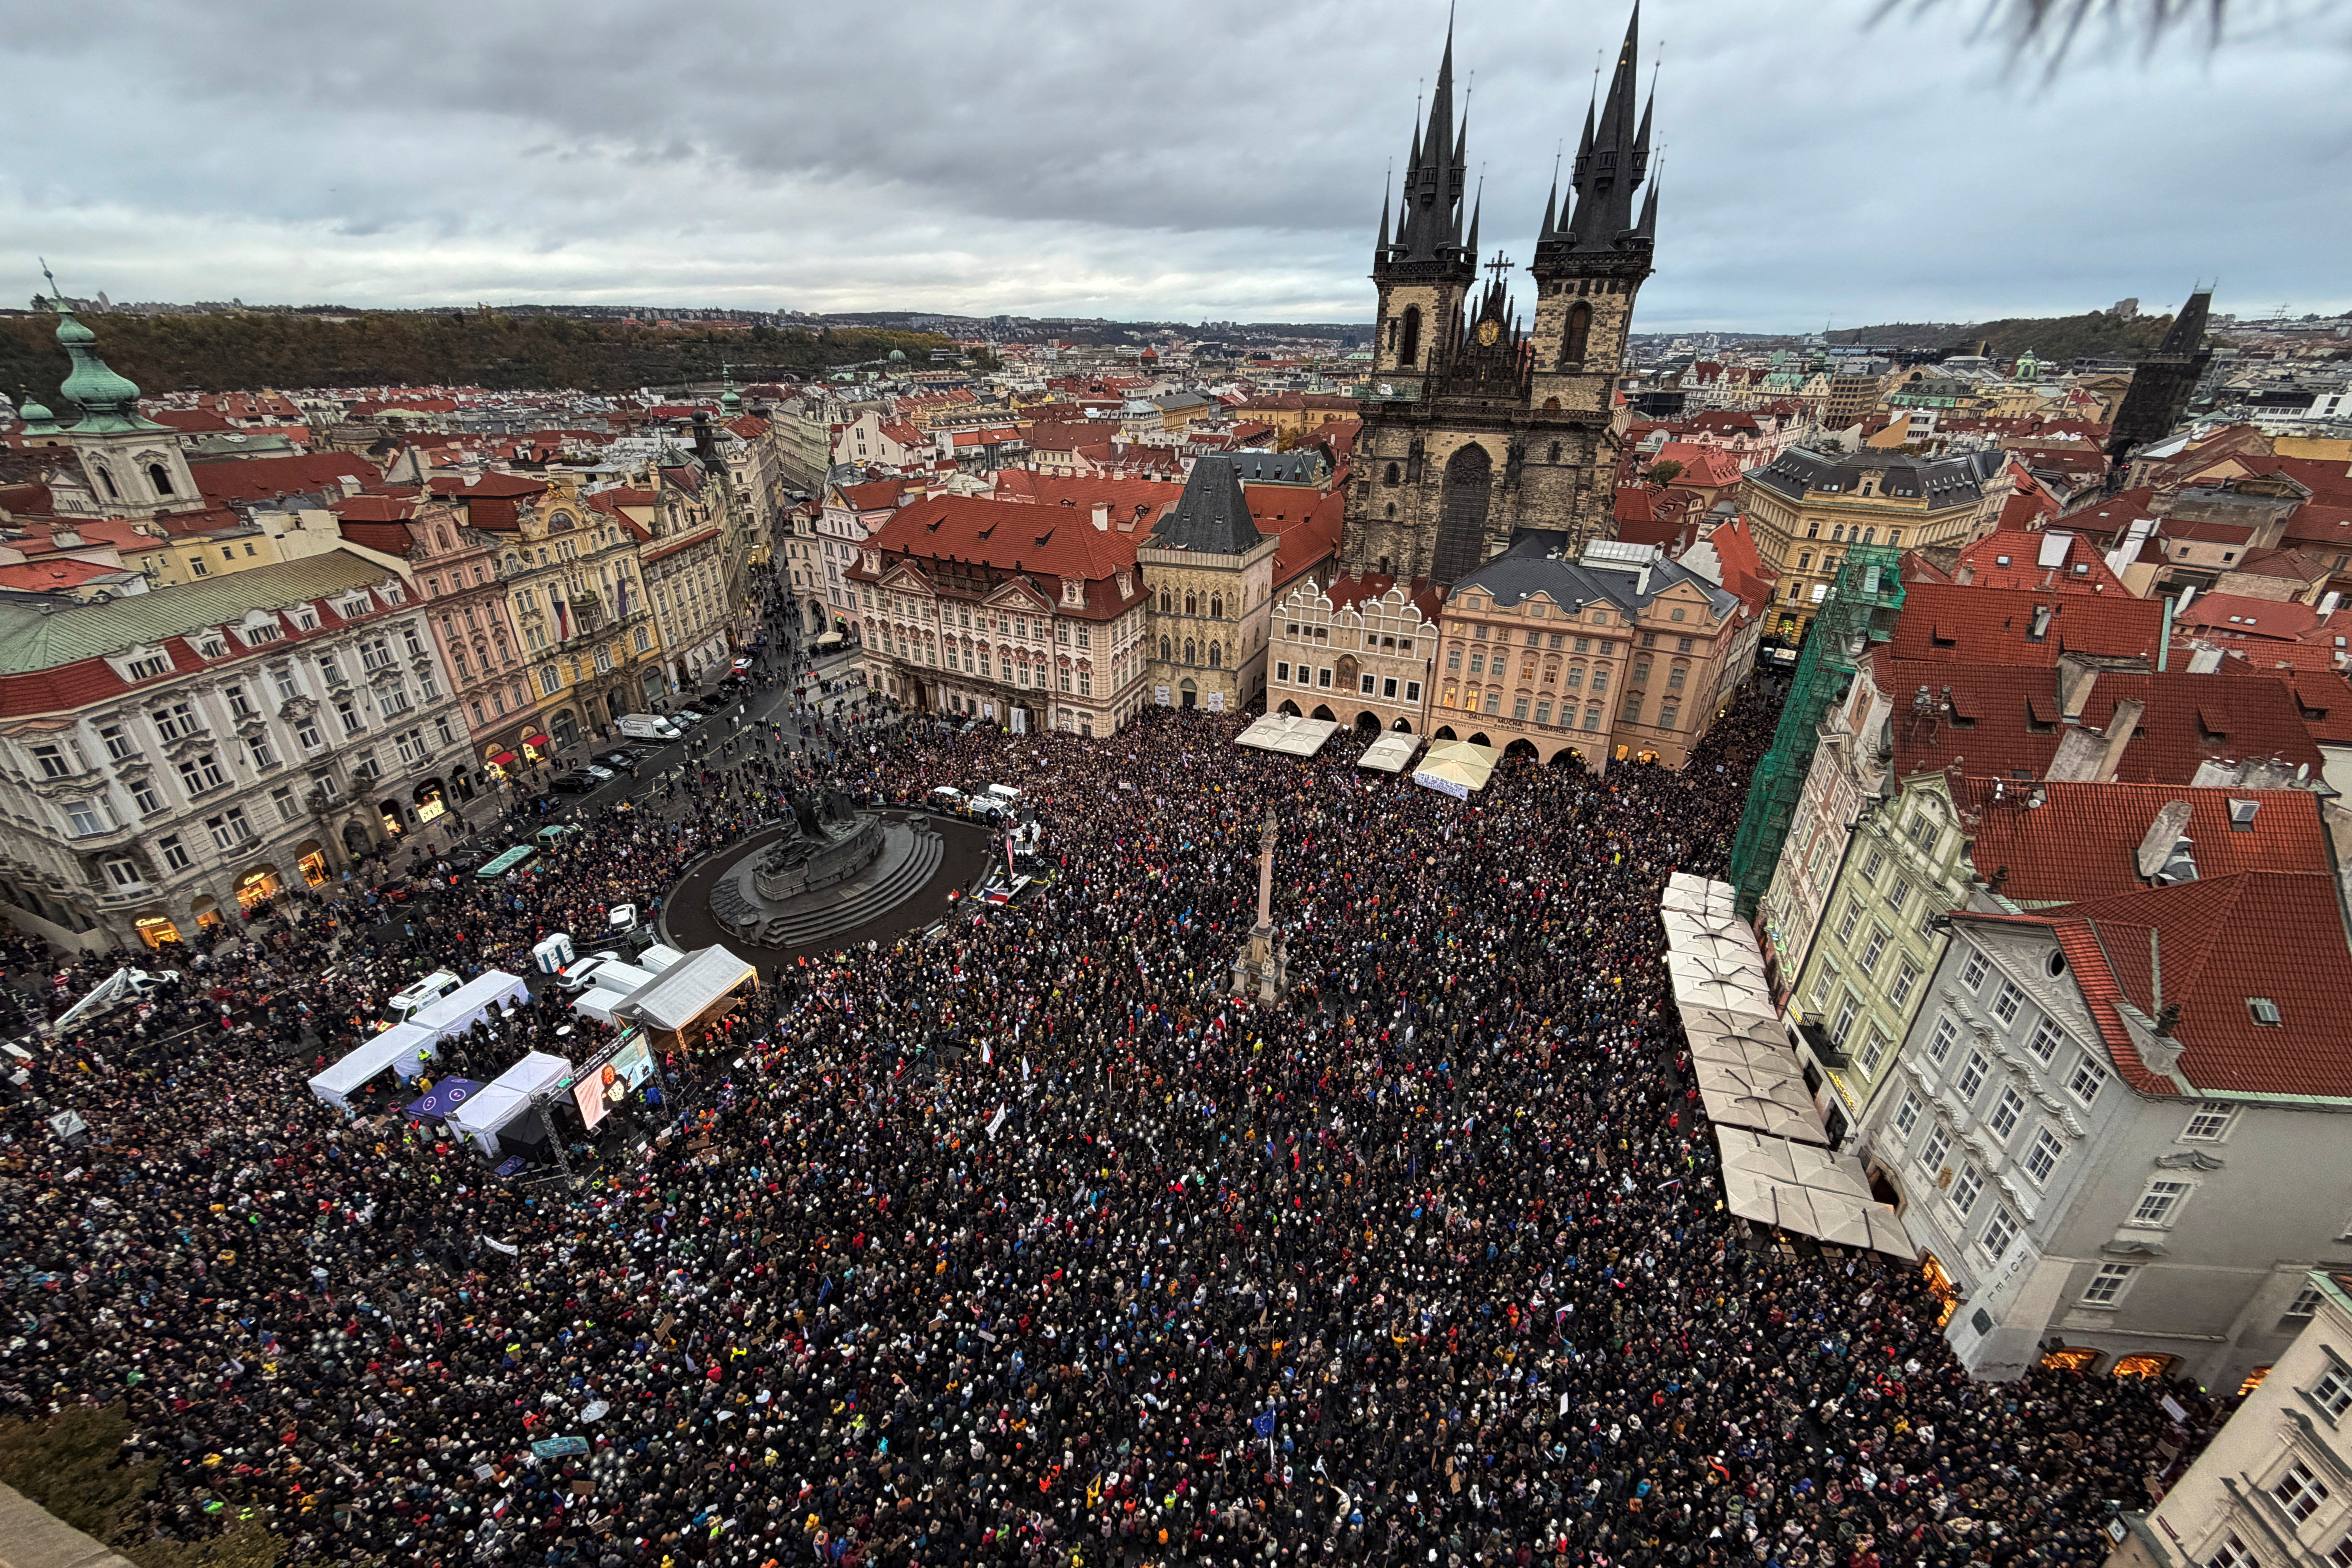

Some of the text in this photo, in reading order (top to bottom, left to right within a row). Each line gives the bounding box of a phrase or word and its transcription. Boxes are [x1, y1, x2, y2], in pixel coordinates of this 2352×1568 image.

[1497, 718, 1522, 727] MUCHA
[1538, 725, 1568, 734] WARHOL
[1986, 1251, 2028, 1302] HOTEL
